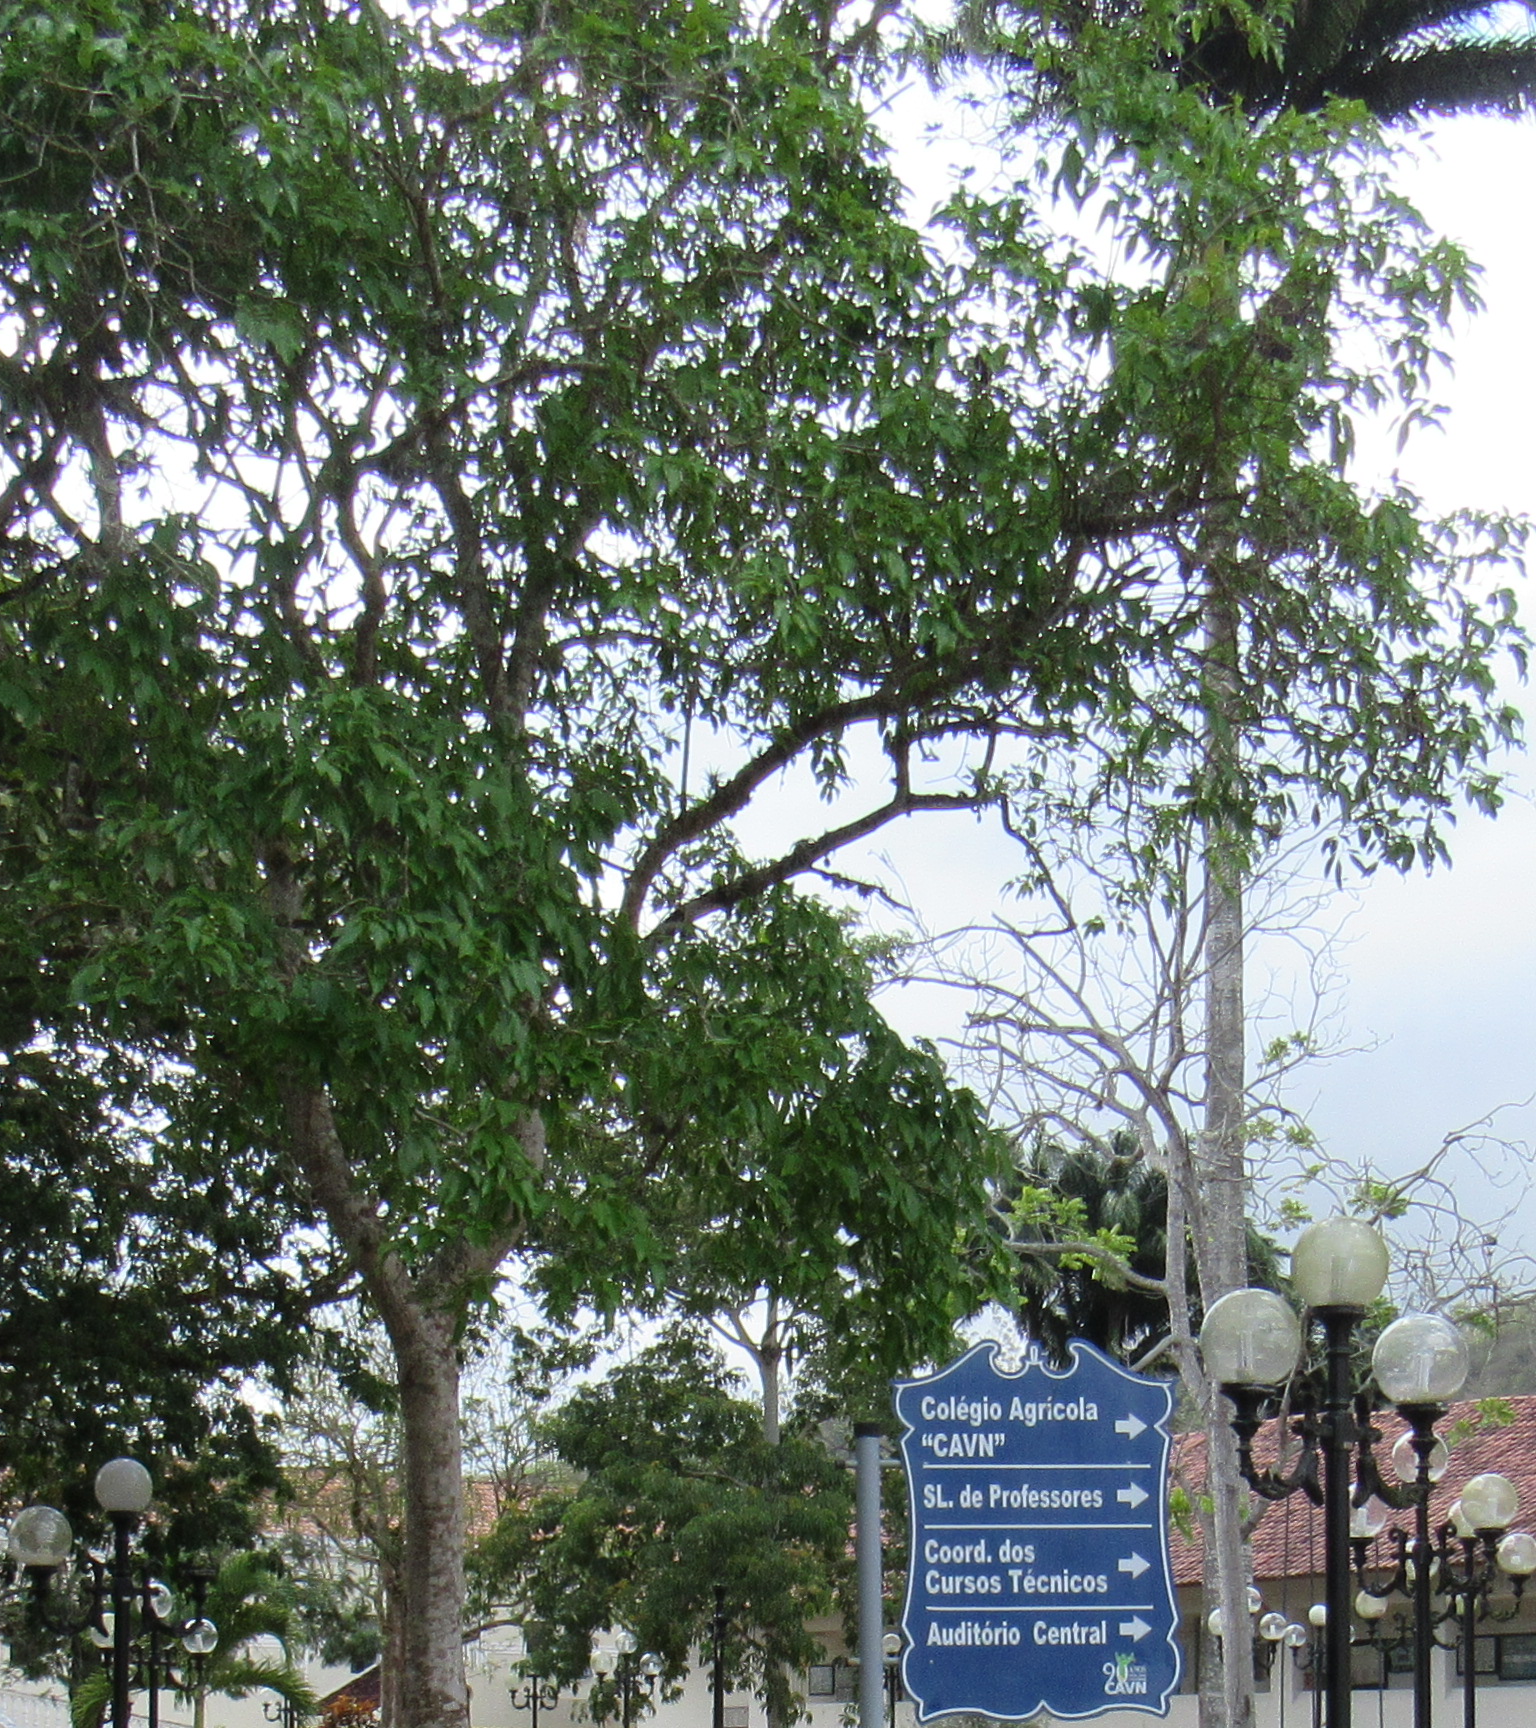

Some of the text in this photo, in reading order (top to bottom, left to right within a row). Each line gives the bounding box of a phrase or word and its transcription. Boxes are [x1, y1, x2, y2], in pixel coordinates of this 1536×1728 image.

[921, 1396, 1099, 1427] Colégio Agrícola
[923, 1484, 1103, 1509] SL. de Professores
[924, 1539, 1036, 1564] Coord. dos
[925, 1568, 1108, 1594] Cursos Técnicos
[926, 1620, 1107, 1646] Auditório Central
[1104, 1681, 1147, 1695] CAVN
